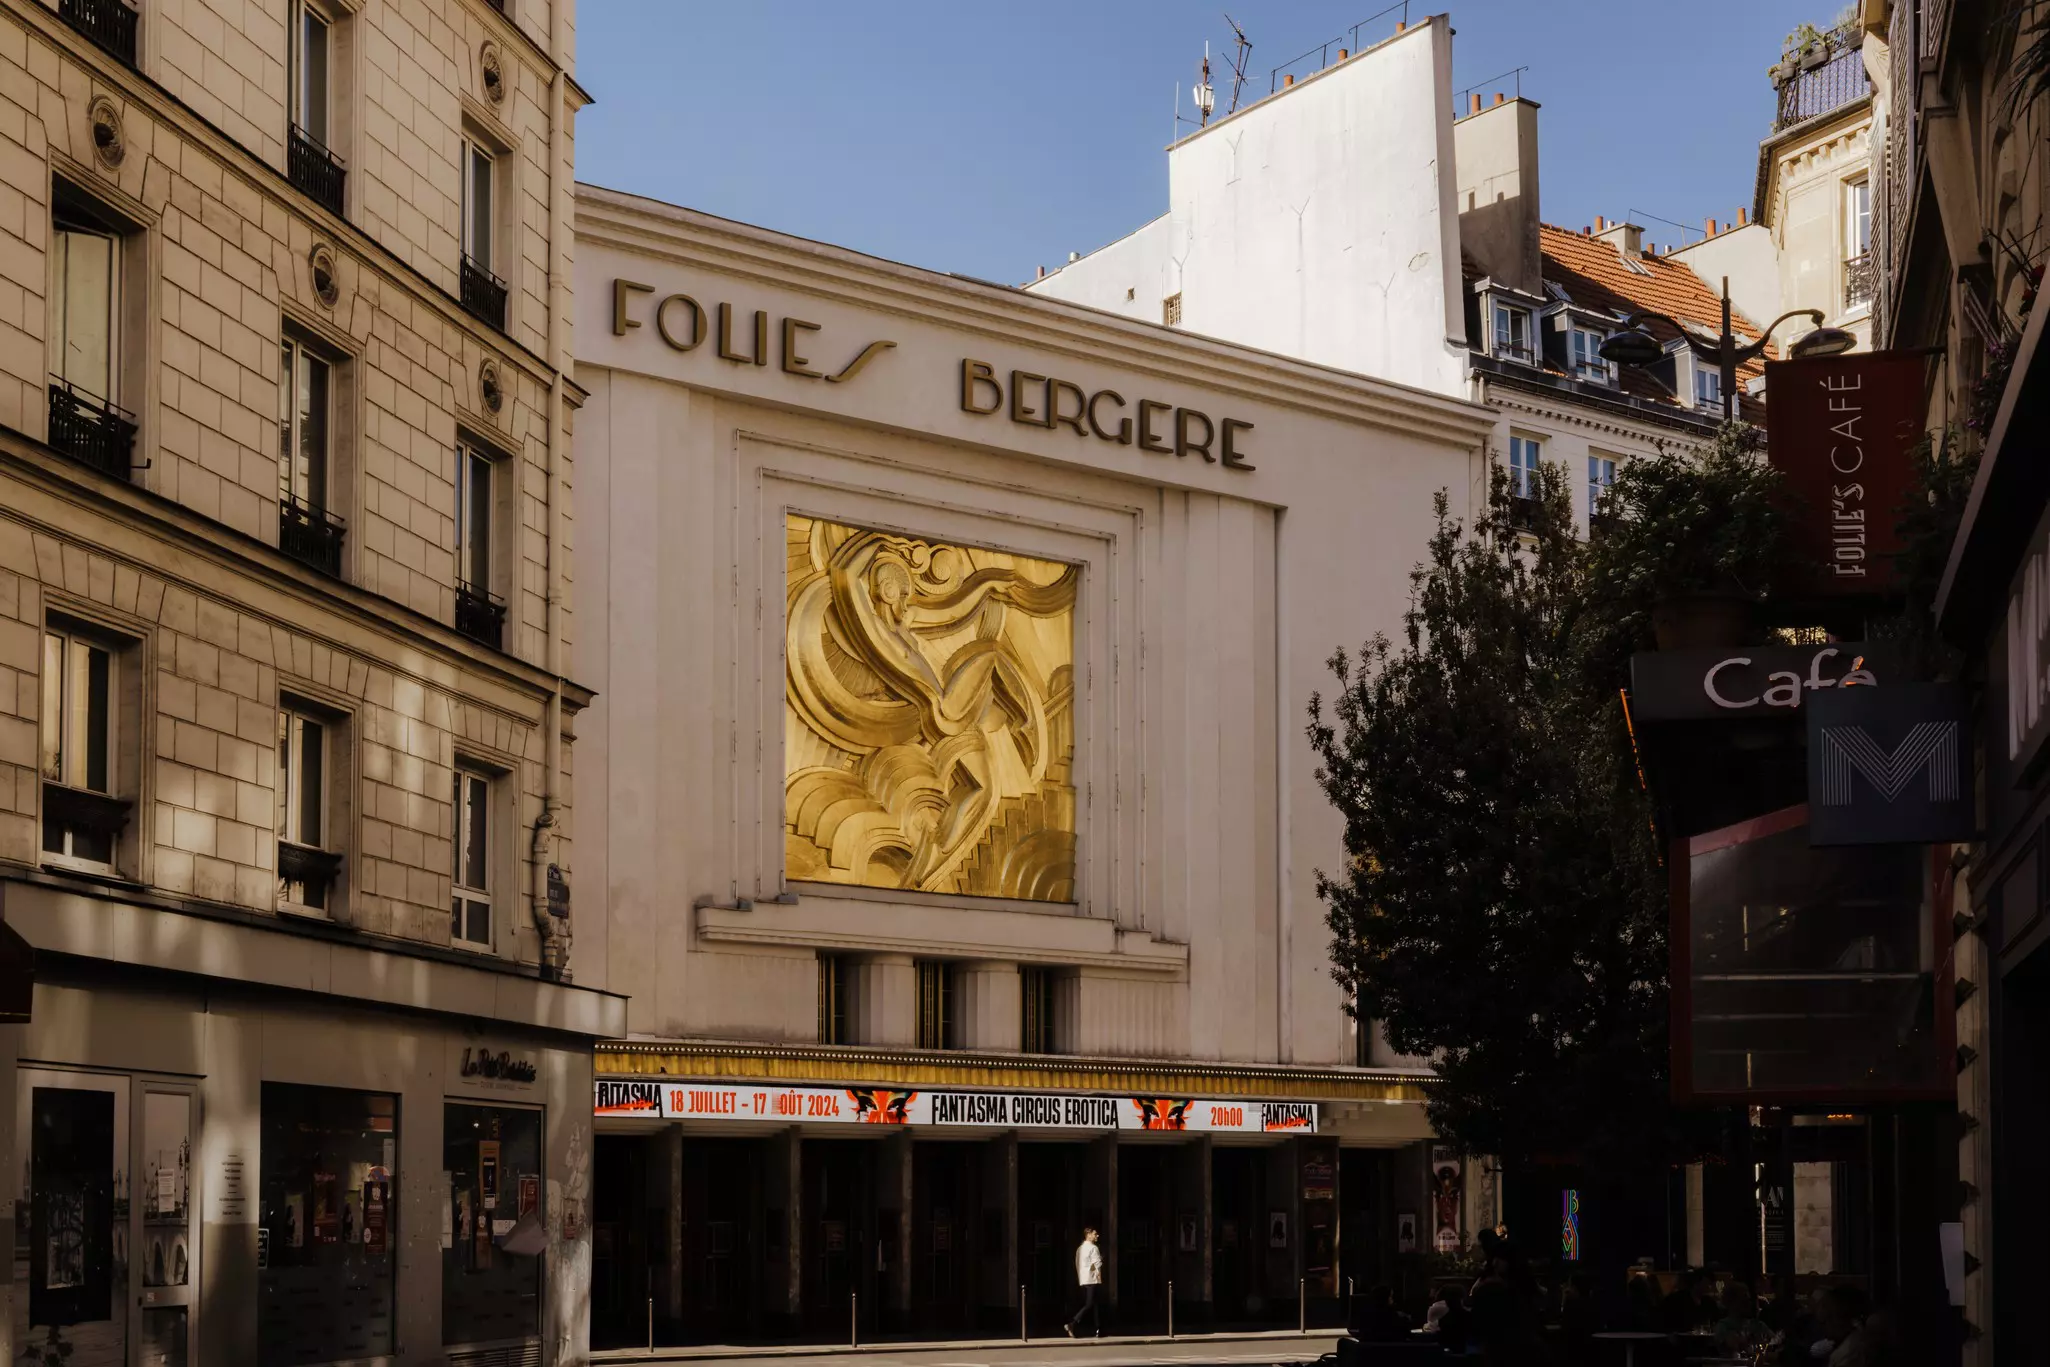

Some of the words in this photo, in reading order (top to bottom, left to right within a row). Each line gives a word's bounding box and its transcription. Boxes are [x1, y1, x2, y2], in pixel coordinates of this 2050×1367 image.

[613, 278, 898, 382] FOLIES
[961, 358, 1257, 472] BERGERE
[1819, 373, 1864, 474] CAFÉ
[1703, 647, 1878, 709] Café
[1821, 720, 1960, 807] M
[670, 1089, 684, 1113] 18
[688, 1090, 737, 1114] JUILLET
[753, 1092, 767, 1115] 17
[807, 1094, 840, 1117] 2024
[932, 1094, 1008, 1125] FANTASMA
[1012, 1096, 1061, 1125] CIRCUS
[1065, 1098, 1120, 1130] EROTICA
[1210, 1106, 1243, 1127] 20h00
[1261, 1103, 1315, 1133] FANTASMA
